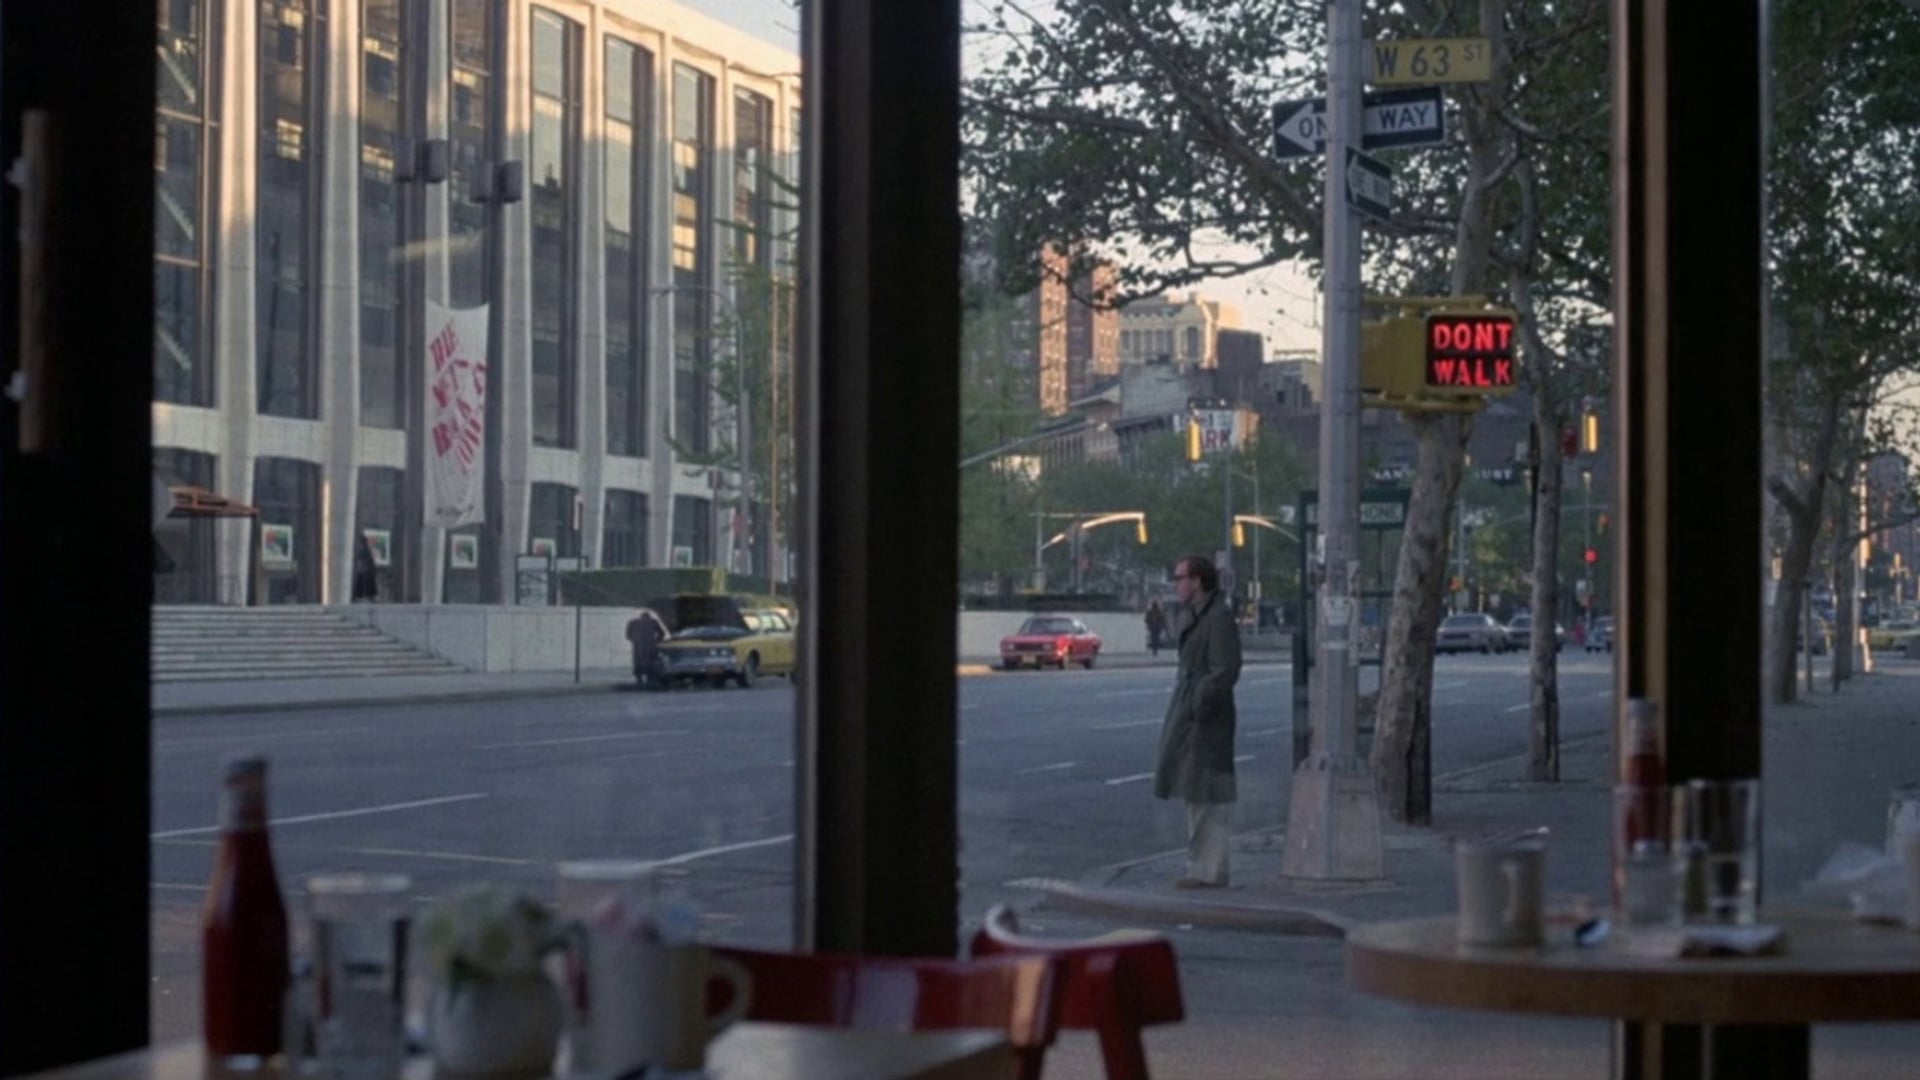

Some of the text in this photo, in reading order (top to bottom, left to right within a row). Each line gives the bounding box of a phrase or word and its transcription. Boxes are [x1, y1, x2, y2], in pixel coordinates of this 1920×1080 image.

[1376, 44, 1483, 78] W 63 ST
[1298, 104, 1428, 139] ON WAY
[1433, 322, 1513, 350] DONT
[1434, 359, 1511, 387] WALK
